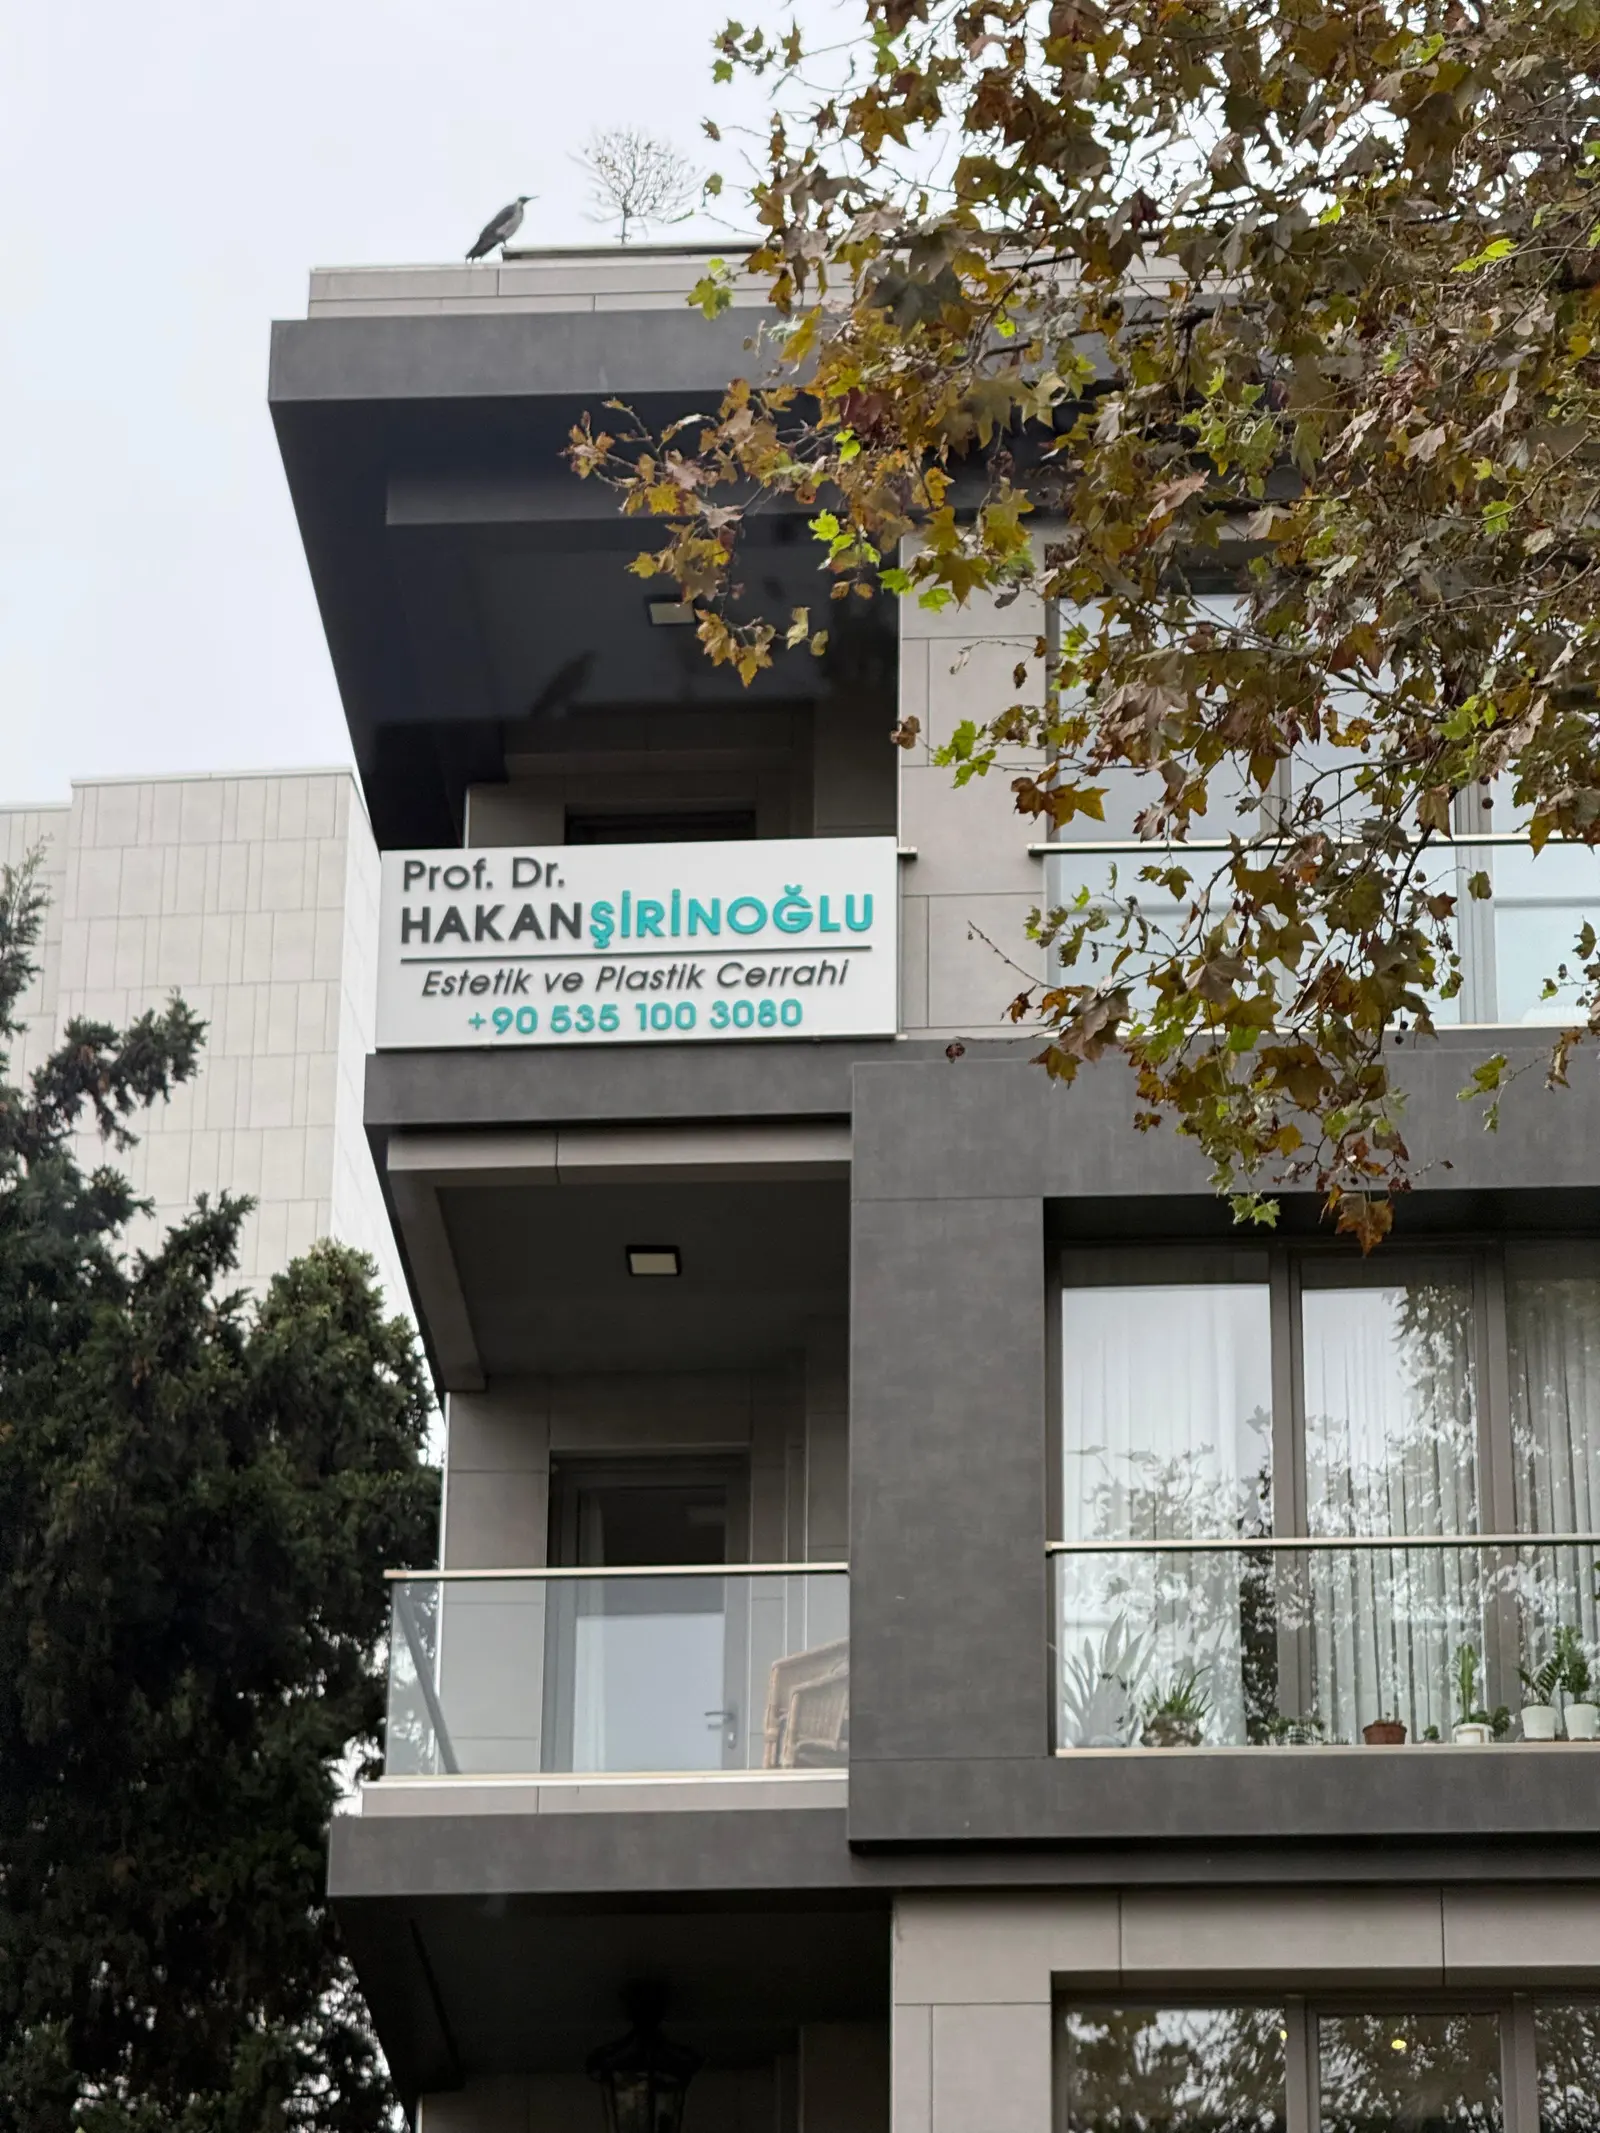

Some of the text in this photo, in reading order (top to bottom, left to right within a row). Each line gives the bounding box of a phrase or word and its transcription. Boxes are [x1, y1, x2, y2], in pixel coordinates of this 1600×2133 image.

[403, 857, 564, 892] Prof. Dr.
[422, 959, 849, 997] Estetik ve Plastik Cerrahi
[468, 999, 802, 1035] +90 535 100 3080
